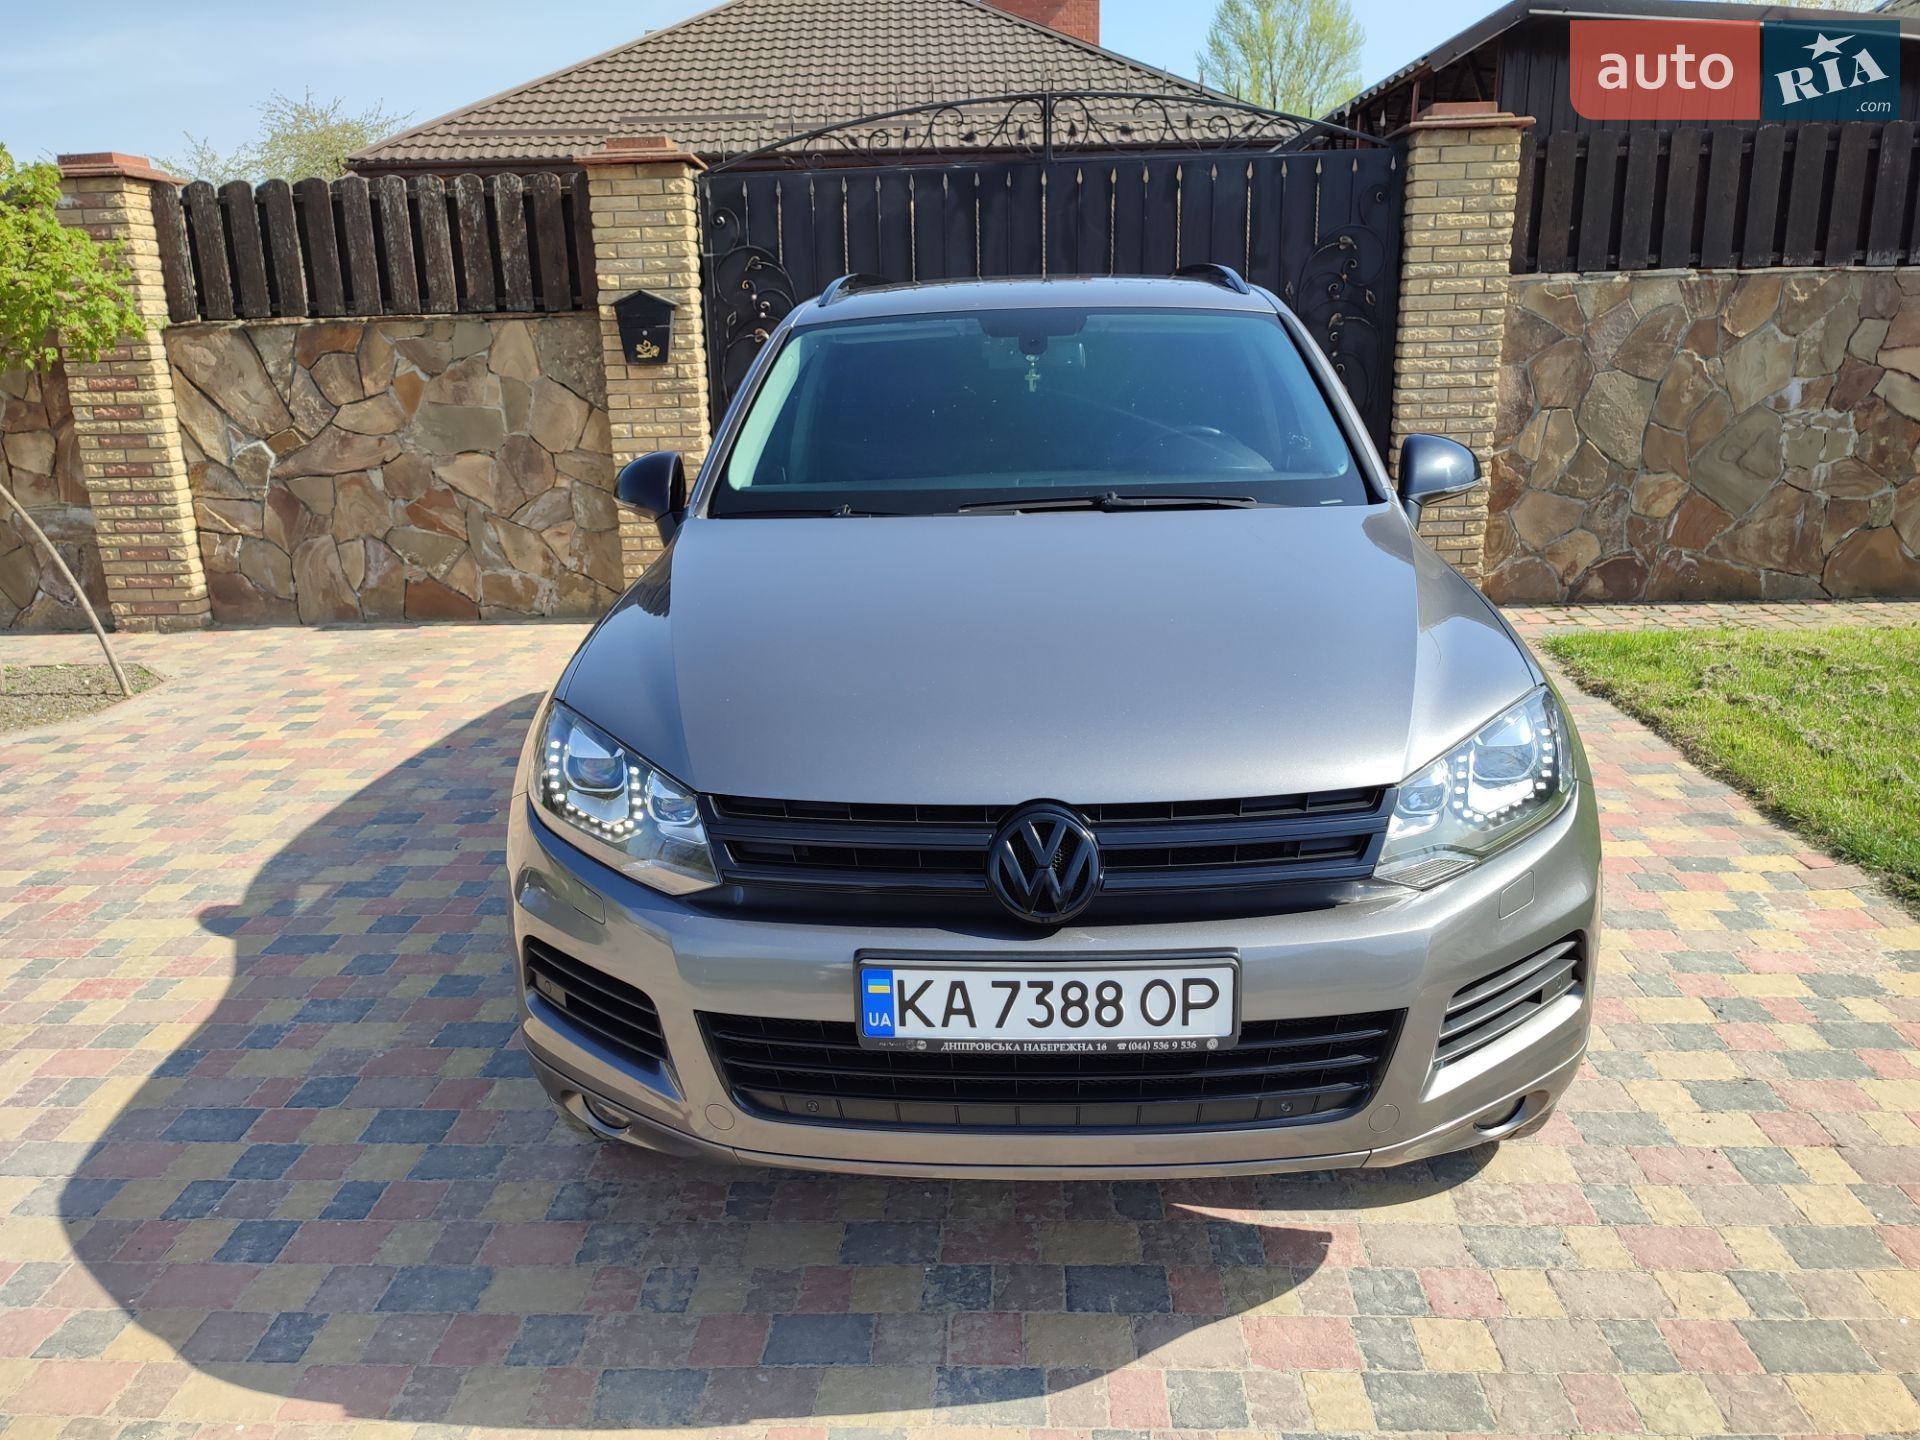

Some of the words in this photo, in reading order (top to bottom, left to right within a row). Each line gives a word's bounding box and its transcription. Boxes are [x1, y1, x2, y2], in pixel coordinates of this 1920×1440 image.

[896, 979, 977, 1028] KA
[991, 979, 1124, 1029] 7388
[1140, 977, 1220, 1027] OP
[868, 1012, 892, 1027] UA
[940, 1041, 1021, 1052] ДНІПРОВСЬКА
[1023, 1042, 1094, 1052] НАБЕРЕЖНА
[1096, 1042, 1108, 1051] 16
[1128, 1040, 1151, 1051] (044)
[1153, 1041, 1169, 1050] 536
[1171, 1041, 1179, 1050] 9
[1180, 1040, 1197, 1050] 536
